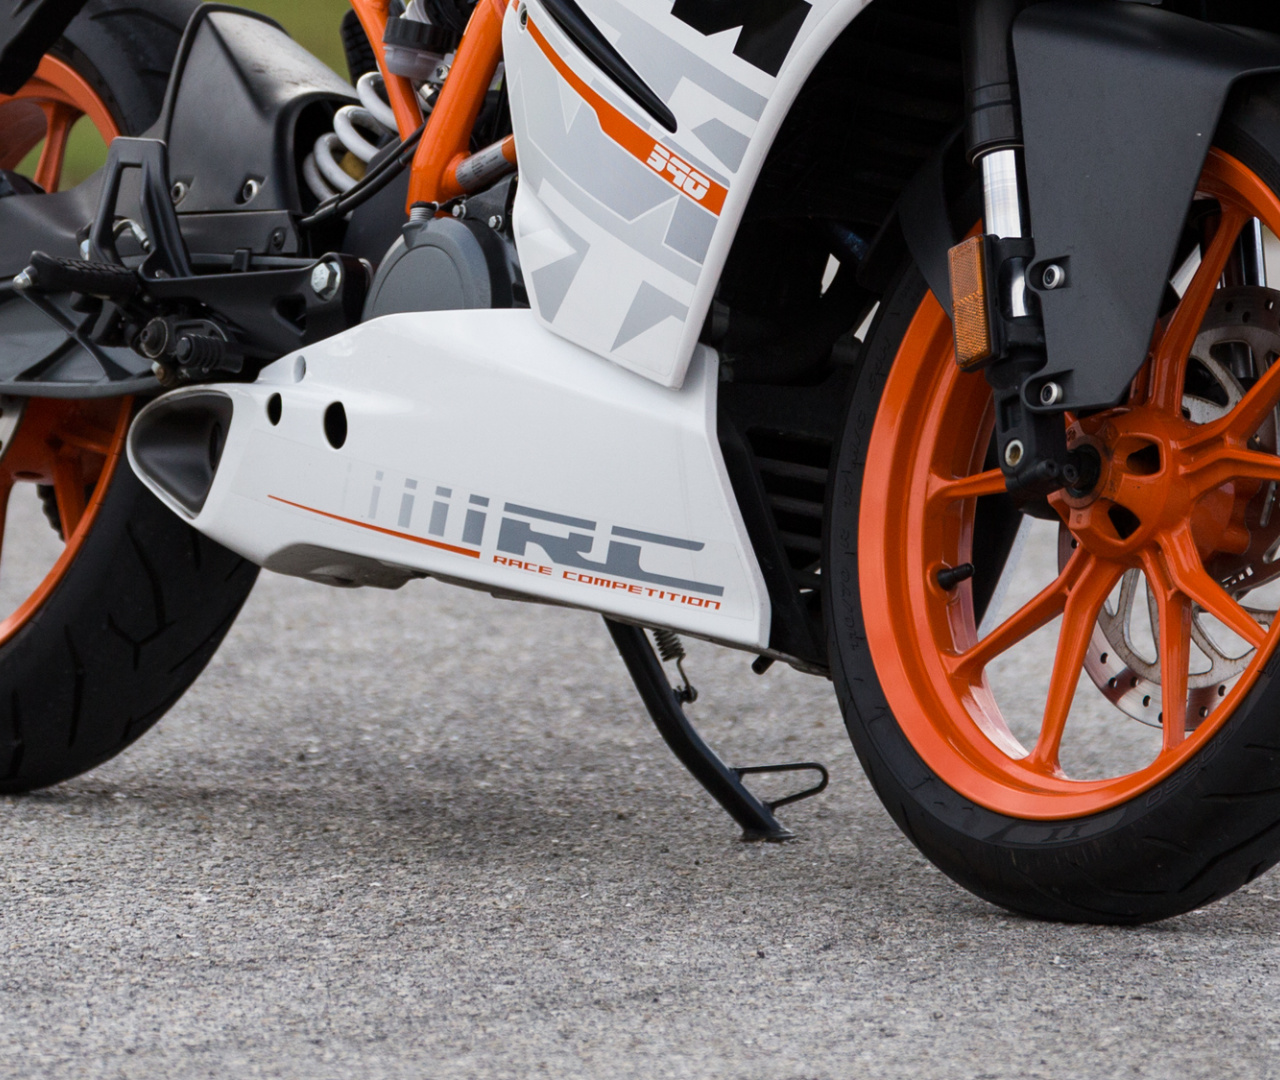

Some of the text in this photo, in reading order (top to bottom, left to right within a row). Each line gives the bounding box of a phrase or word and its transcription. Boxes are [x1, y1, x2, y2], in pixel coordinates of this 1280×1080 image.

[646, 143, 710, 201] 390
[493, 555, 722, 610] RACE COMPETITION
[496, 502, 724, 596] RC
[1146, 721, 1237, 808] ROSSO
